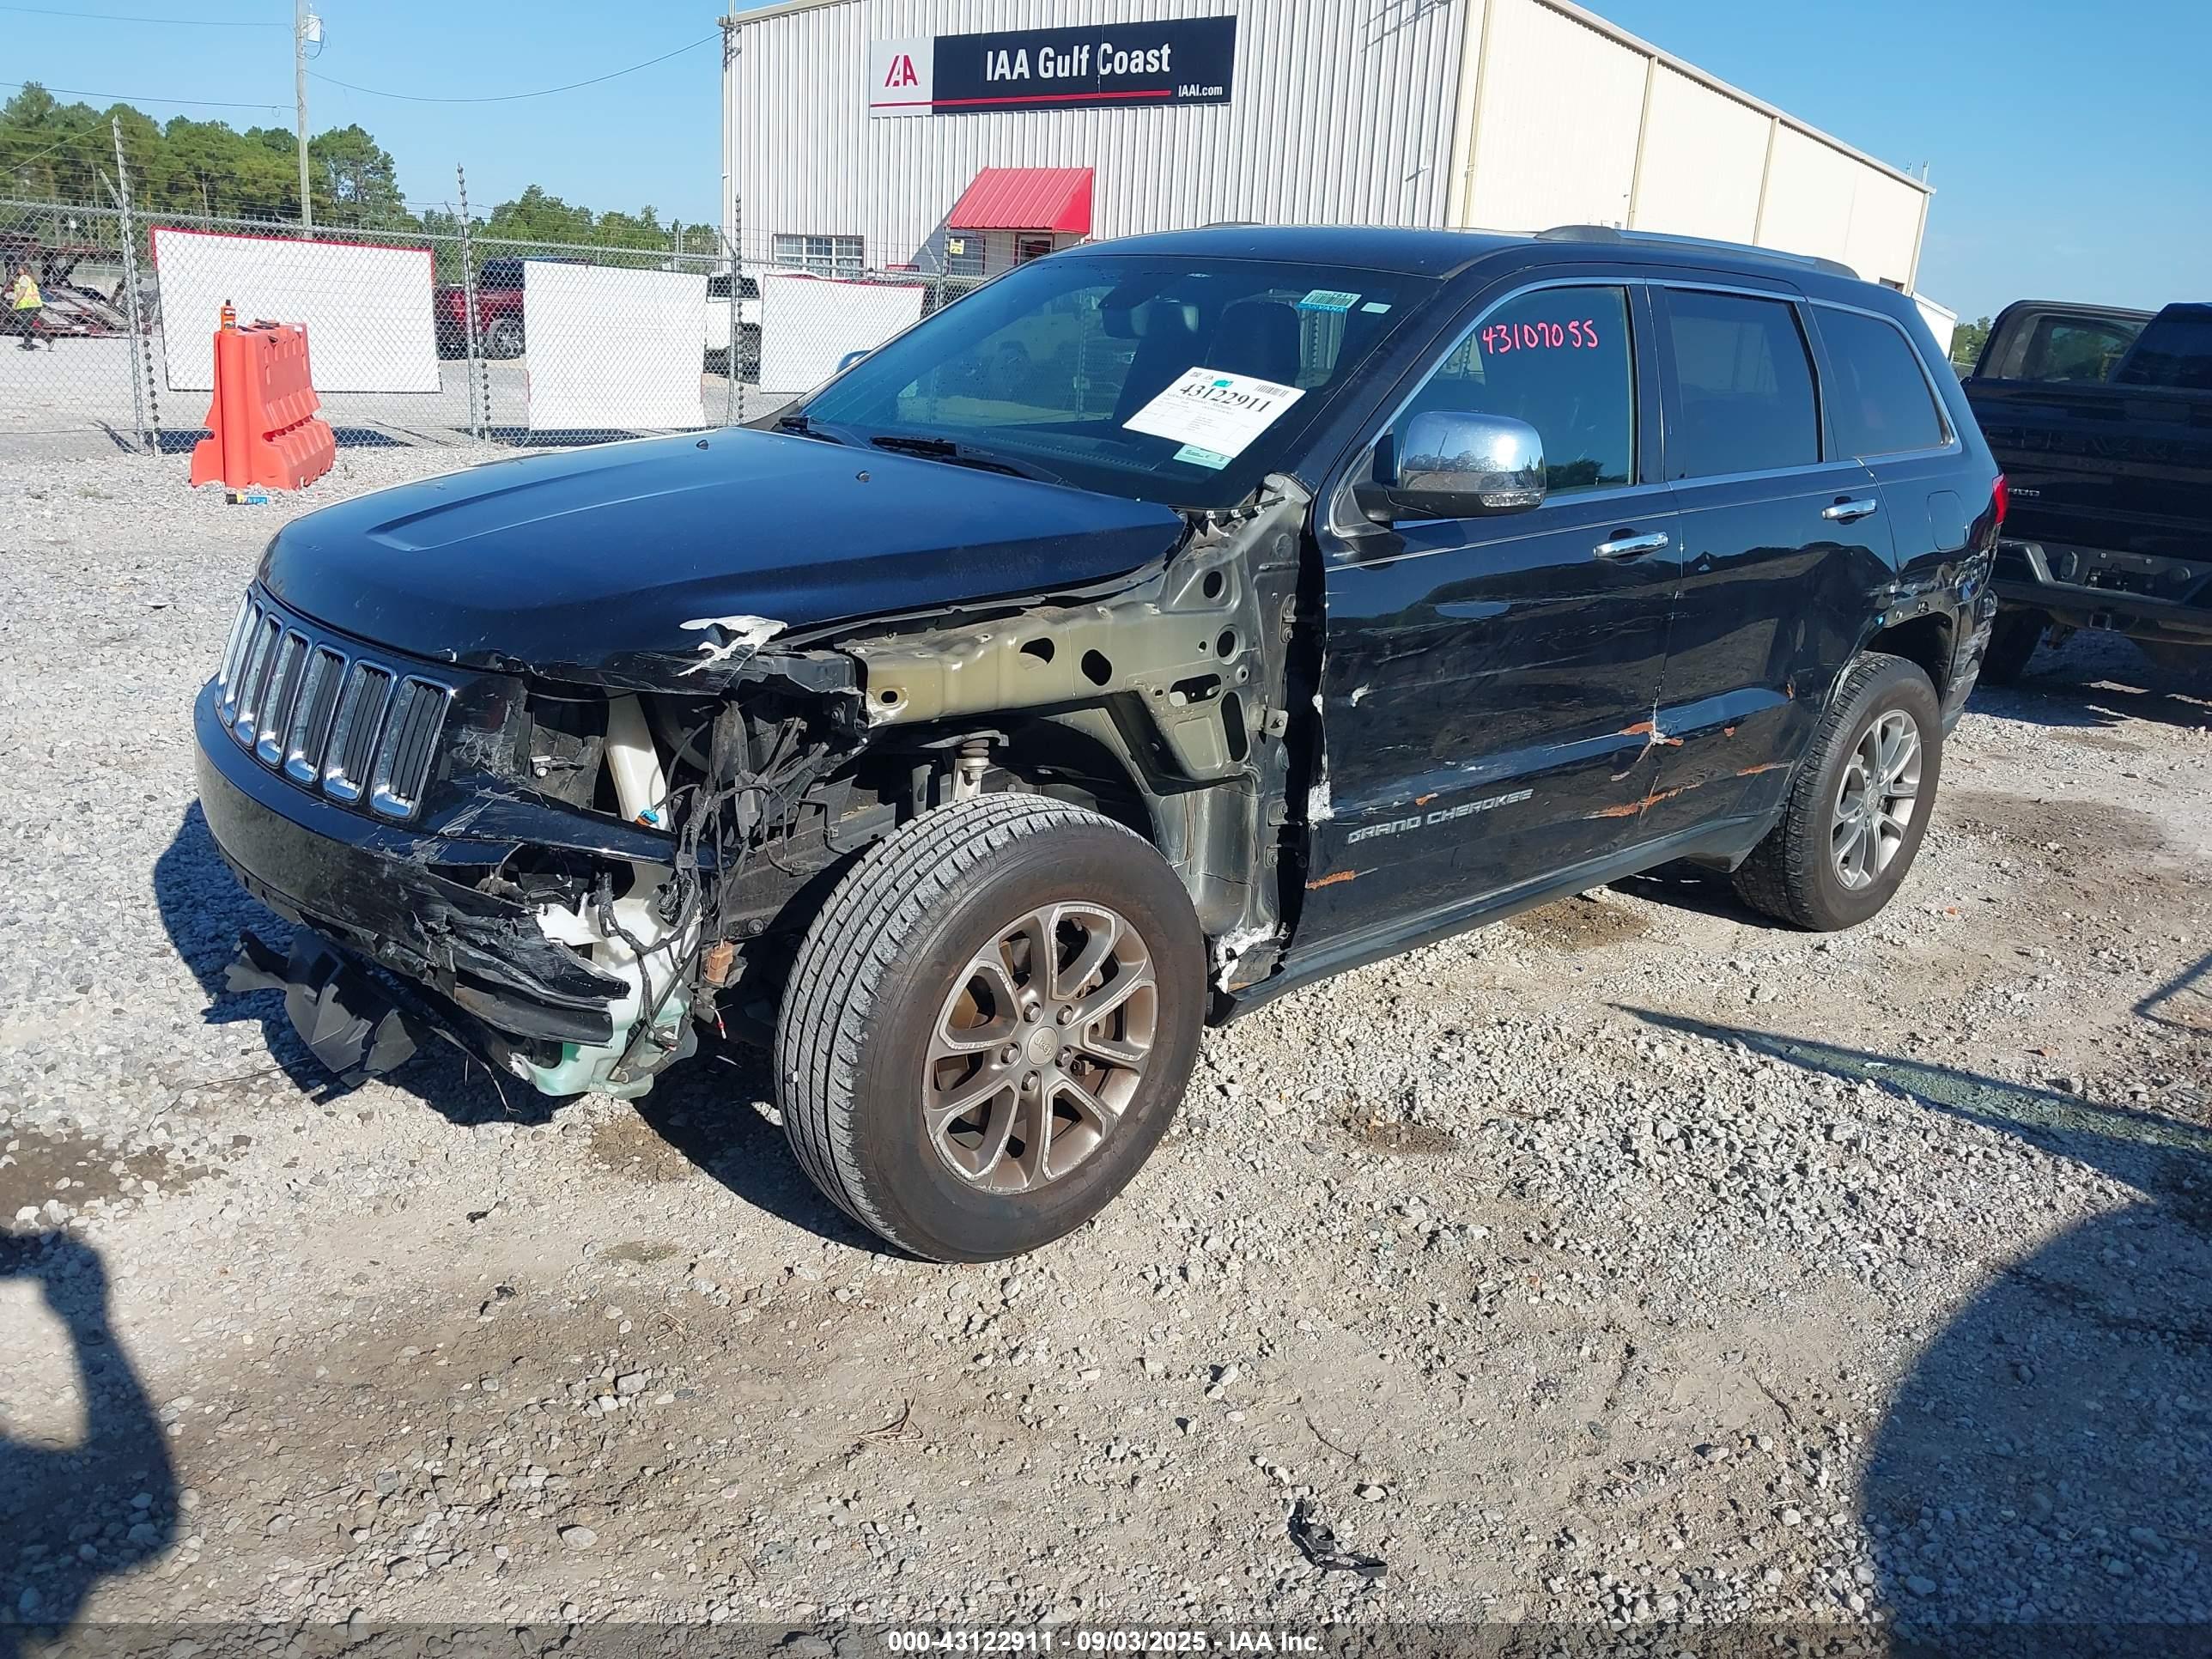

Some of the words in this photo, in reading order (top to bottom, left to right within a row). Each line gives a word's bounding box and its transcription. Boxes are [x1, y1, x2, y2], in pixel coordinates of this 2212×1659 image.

[987, 50, 1030, 82] IAA
[1038, 44, 1090, 80] Gulf
[1098, 42, 1171, 76] Coast
[1178, 84, 1223, 97] IAAI.com
[1179, 383, 1273, 412] 43122911
[1348, 816, 1421, 844] GRAND
[1426, 788, 1534, 825] CHEROKEE
[1035, 1036, 1052, 1055] Jeep
